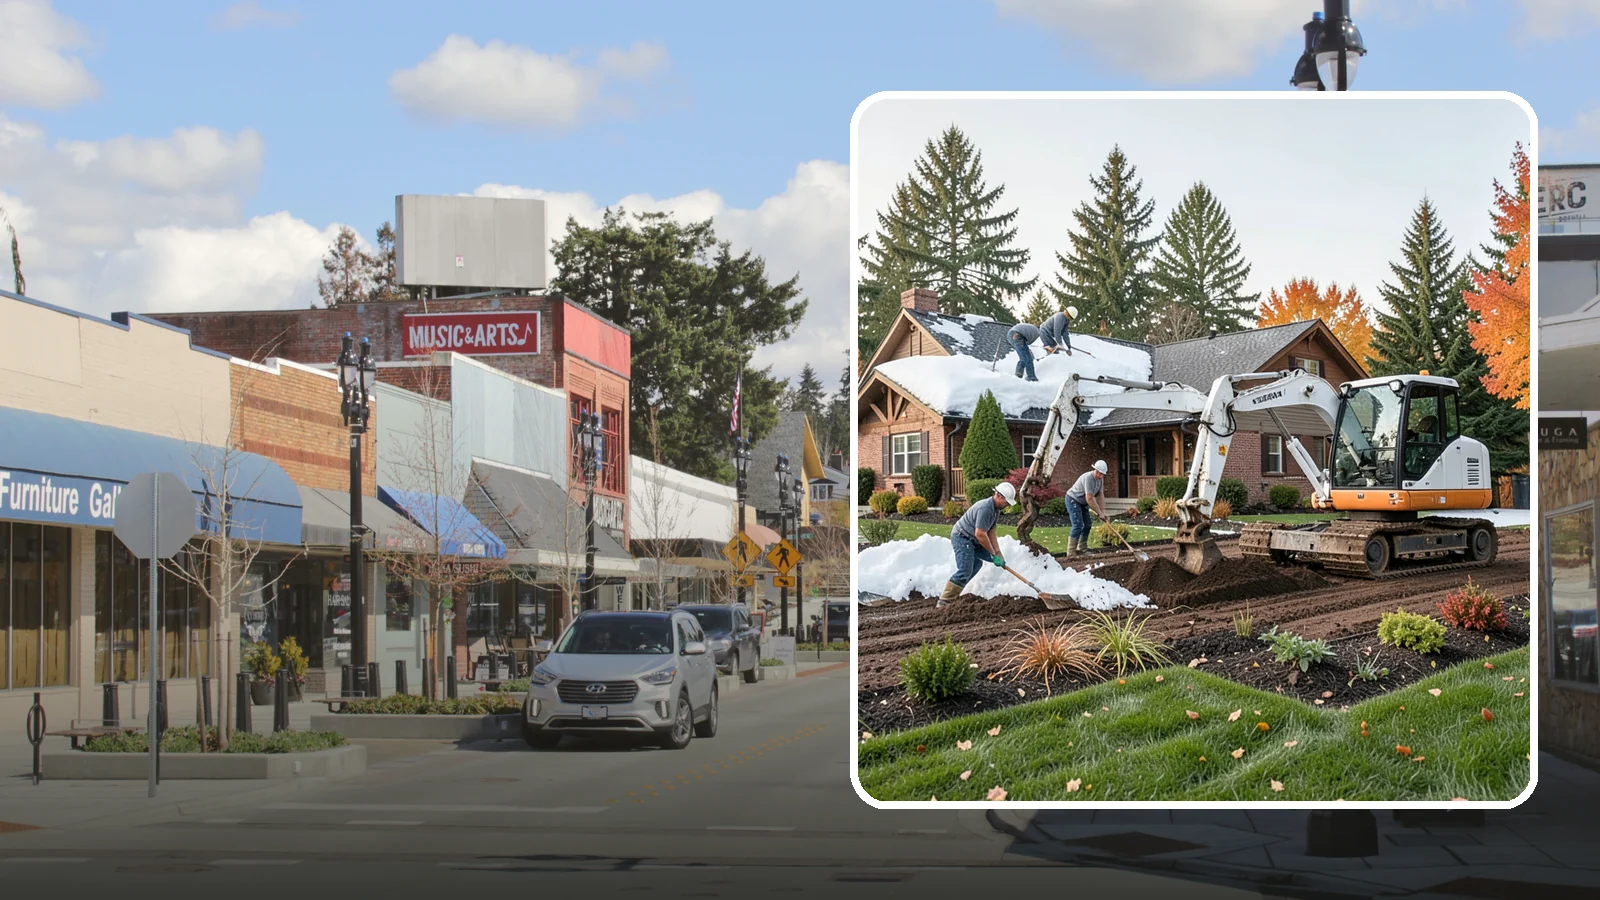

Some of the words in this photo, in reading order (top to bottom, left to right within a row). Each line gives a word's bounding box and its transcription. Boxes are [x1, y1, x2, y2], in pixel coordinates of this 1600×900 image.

[408, 323, 520, 348] MUSIC&ARTS
[0, 471, 79, 515] Furniture
[453, 563, 480, 574] SUSHI
